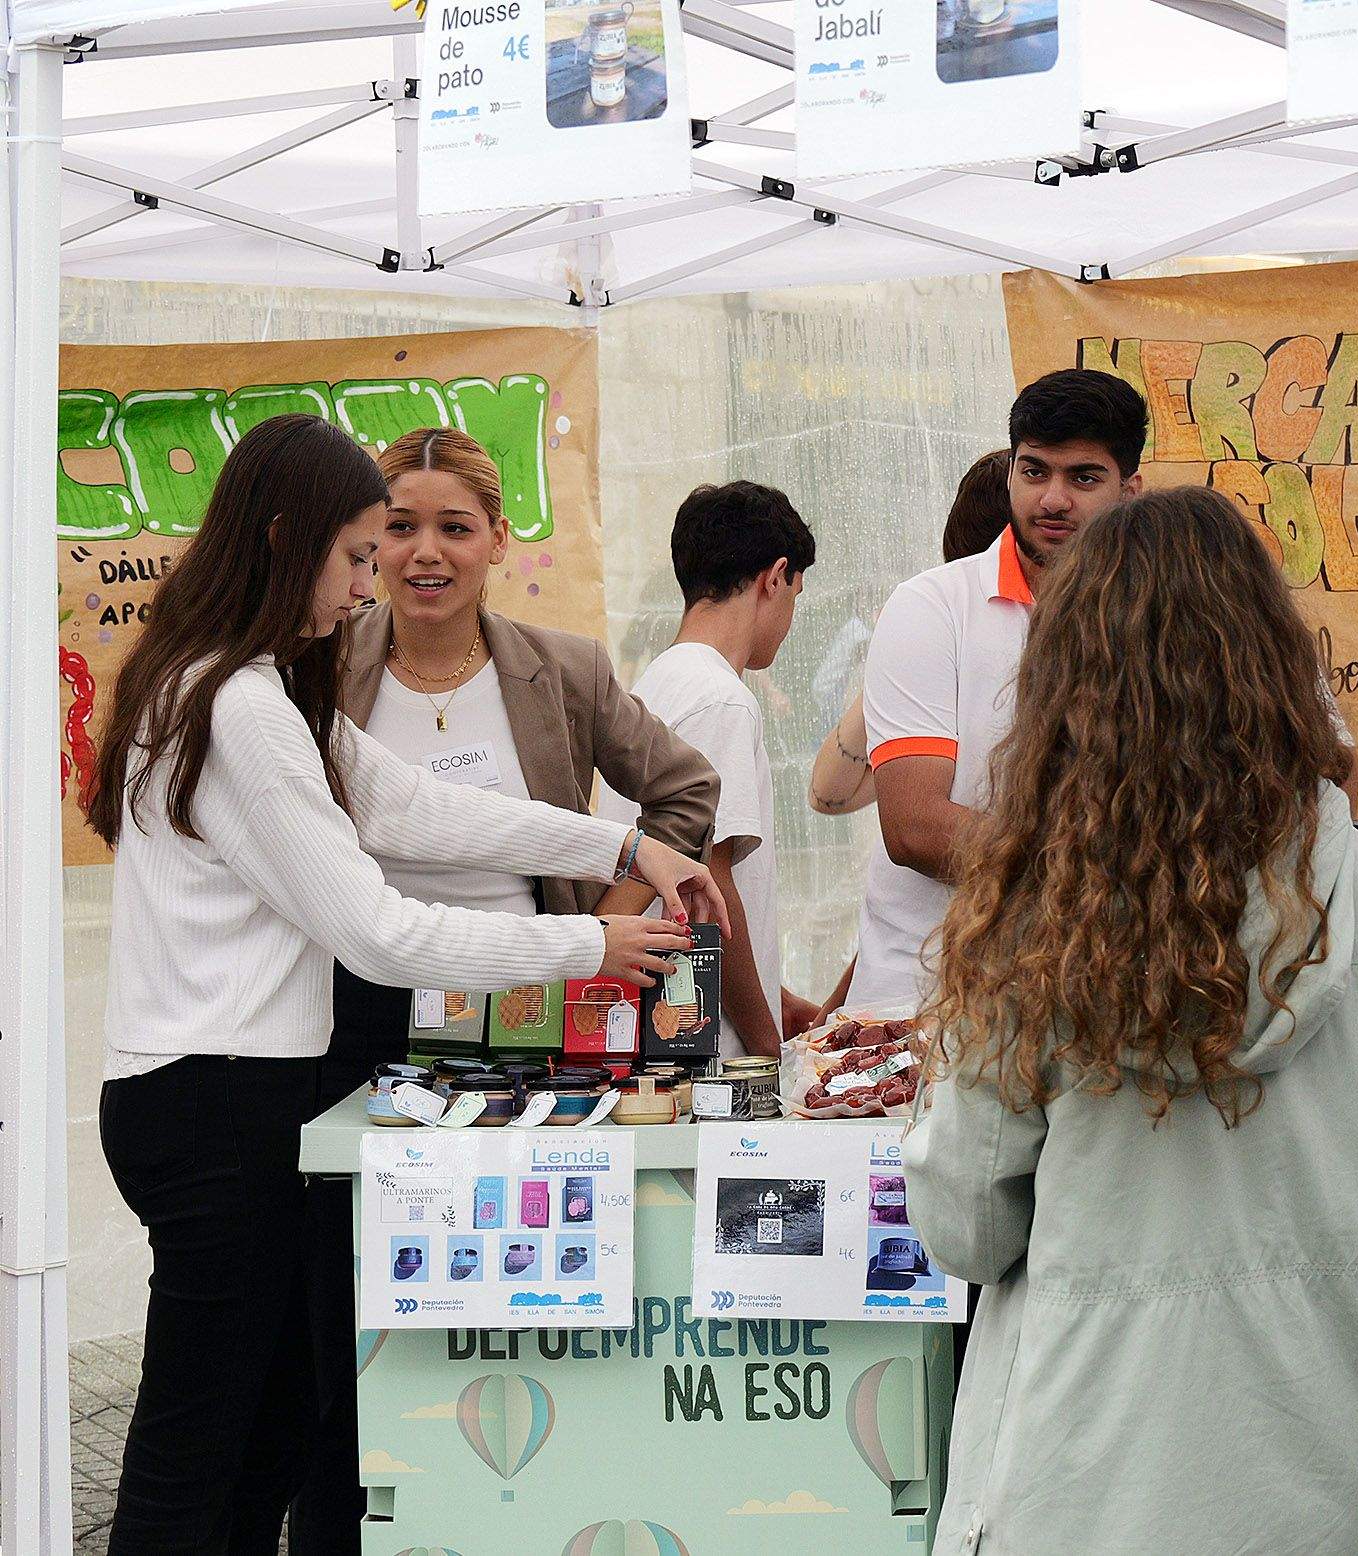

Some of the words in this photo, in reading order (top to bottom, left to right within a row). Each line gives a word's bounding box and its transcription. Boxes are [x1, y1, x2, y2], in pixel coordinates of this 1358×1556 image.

[441, 2, 520, 31] Mousse
[815, 8, 883, 41] Jabalí
[439, 37, 464, 61] de
[502, 34, 531, 62] 4€
[438, 64, 483, 96] pato
[100, 602, 151, 626] APO
[431, 750, 489, 772] ECOSIM
[532, 1148, 610, 1164] Lenda
[383, 1188, 452, 1196] ULTRAMARINOS
[839, 1189, 856, 1203] 6€
[601, 1243, 618, 1257] 5€
[839, 1246, 856, 1260] 4€
[738, 1294, 782, 1302] Deputación
[663, 1363, 724, 1422] NA
[745, 1362, 831, 1422] ESO
